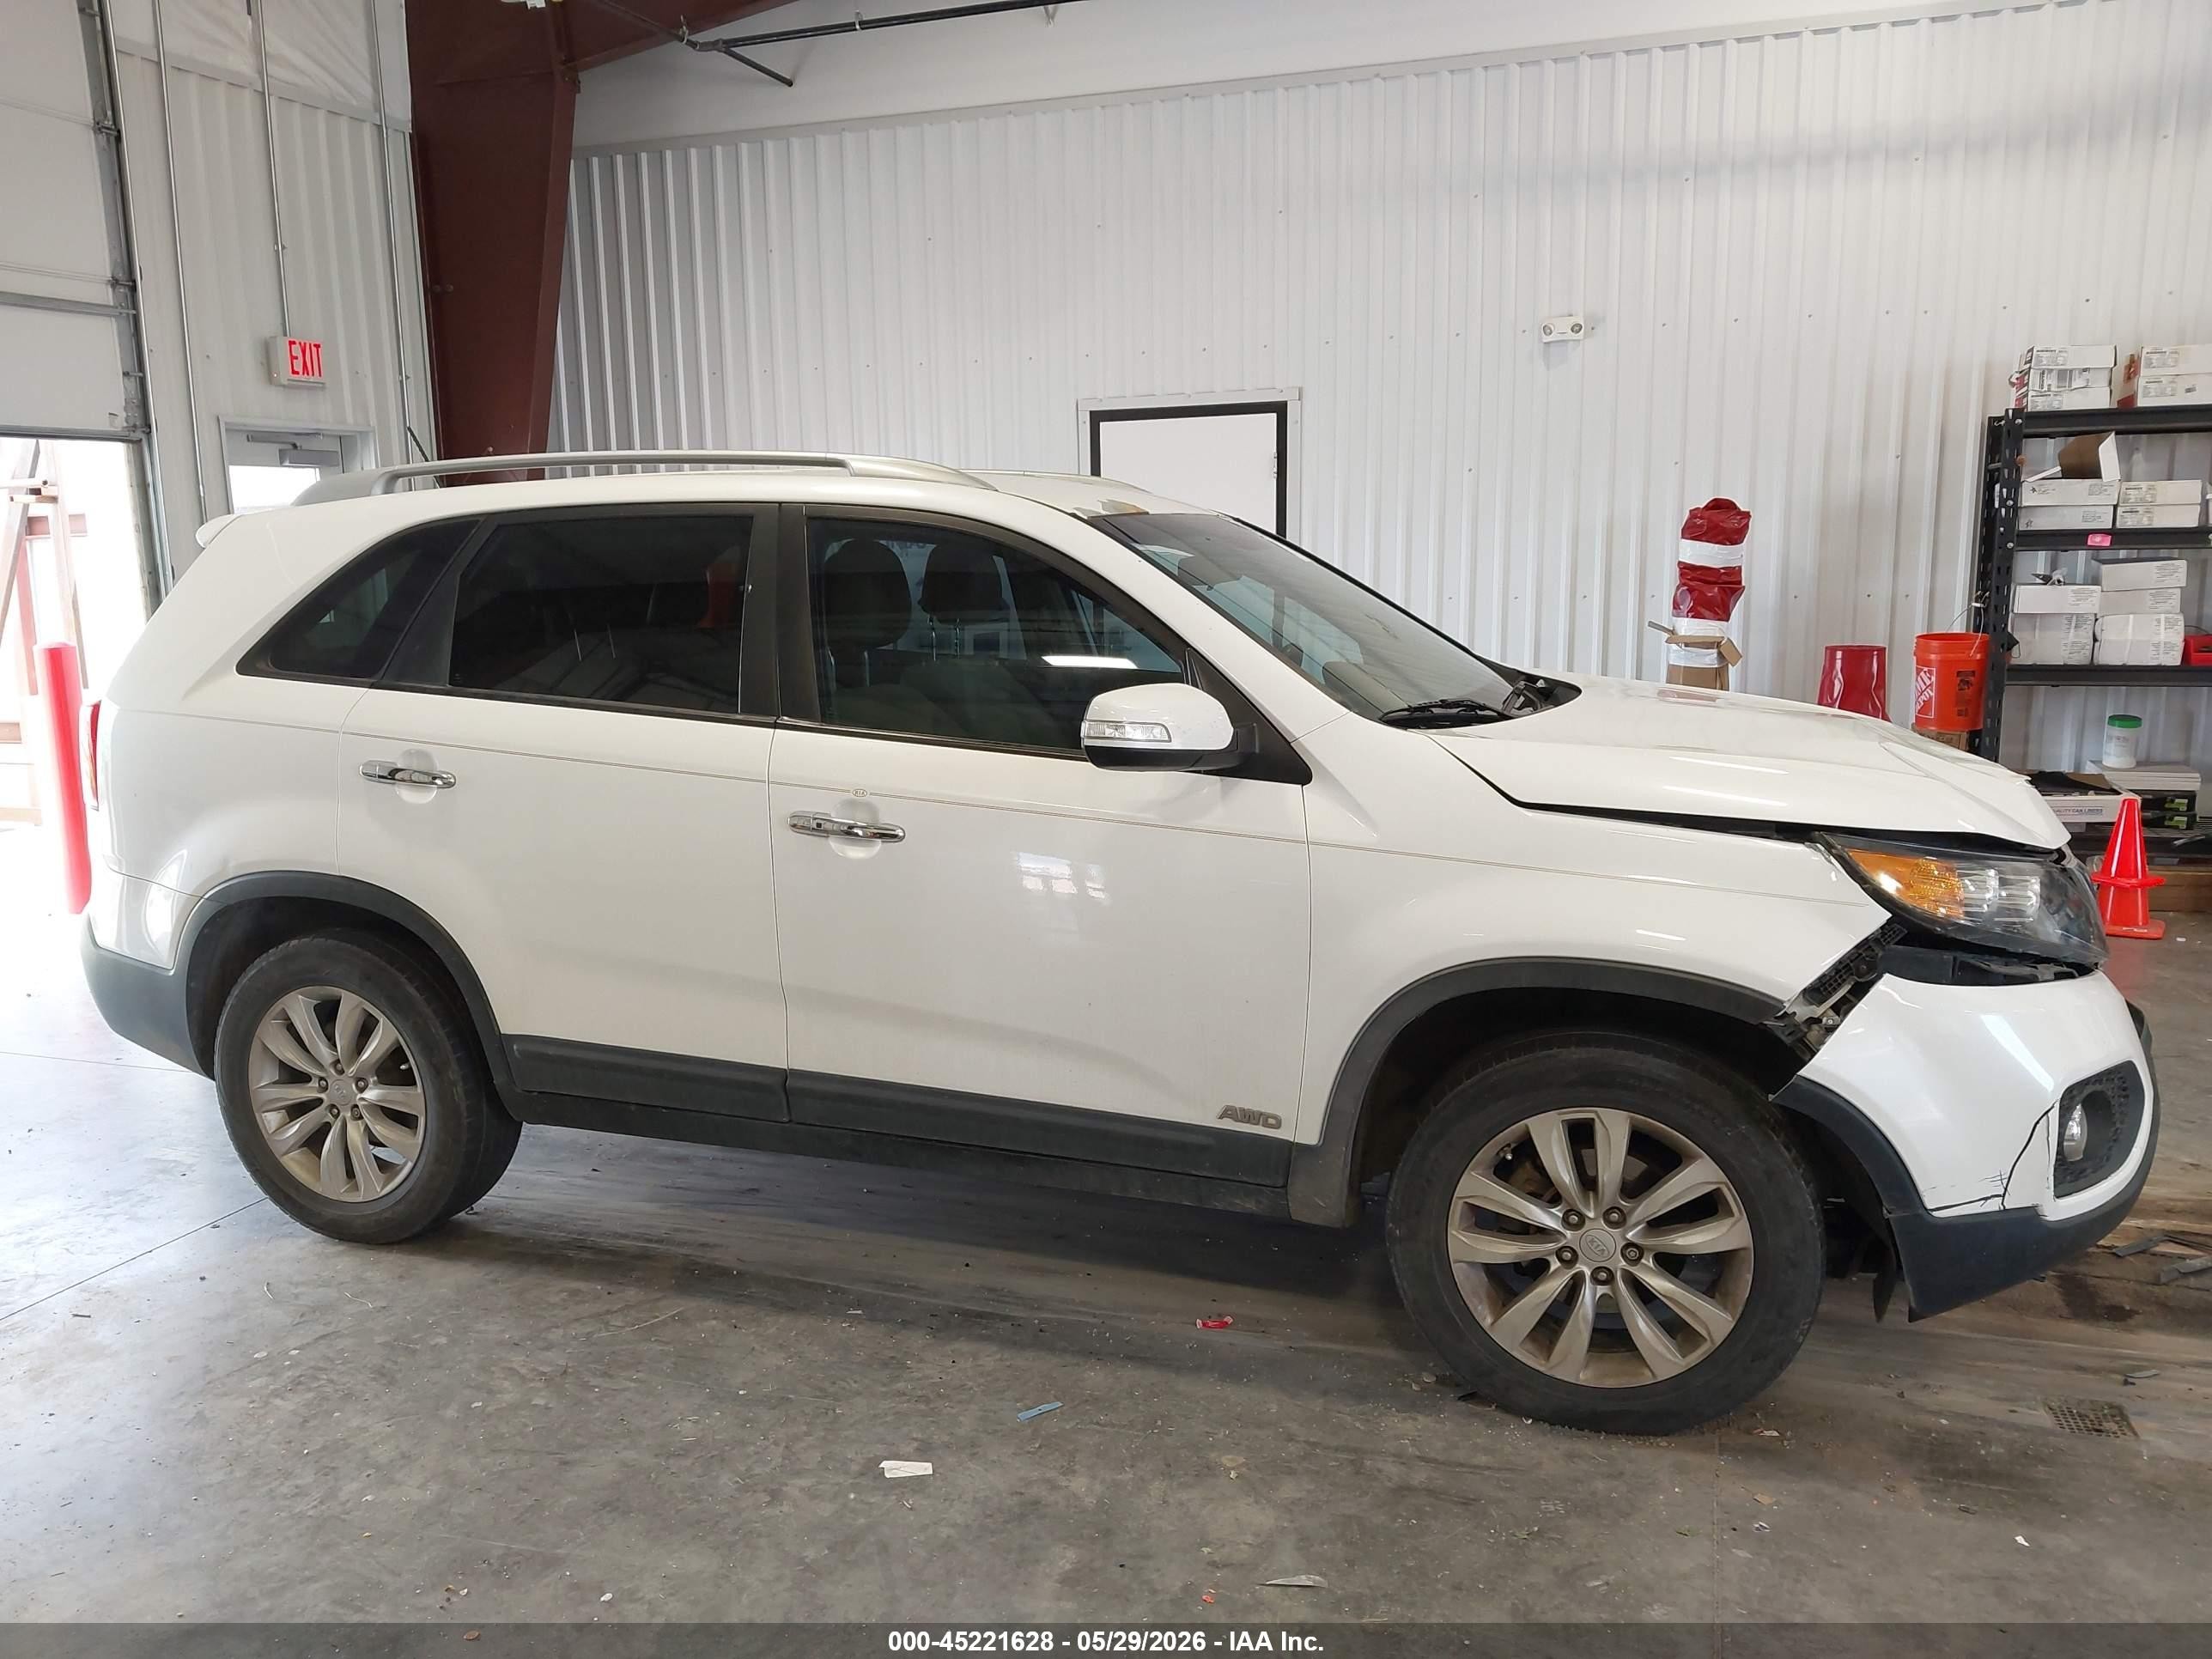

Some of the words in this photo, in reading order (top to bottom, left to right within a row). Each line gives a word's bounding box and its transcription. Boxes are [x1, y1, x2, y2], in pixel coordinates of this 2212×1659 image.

[288, 340, 322, 378] EXIT
[1216, 1104, 1283, 1130] AWD
[1588, 1237, 1607, 1256] KIA
